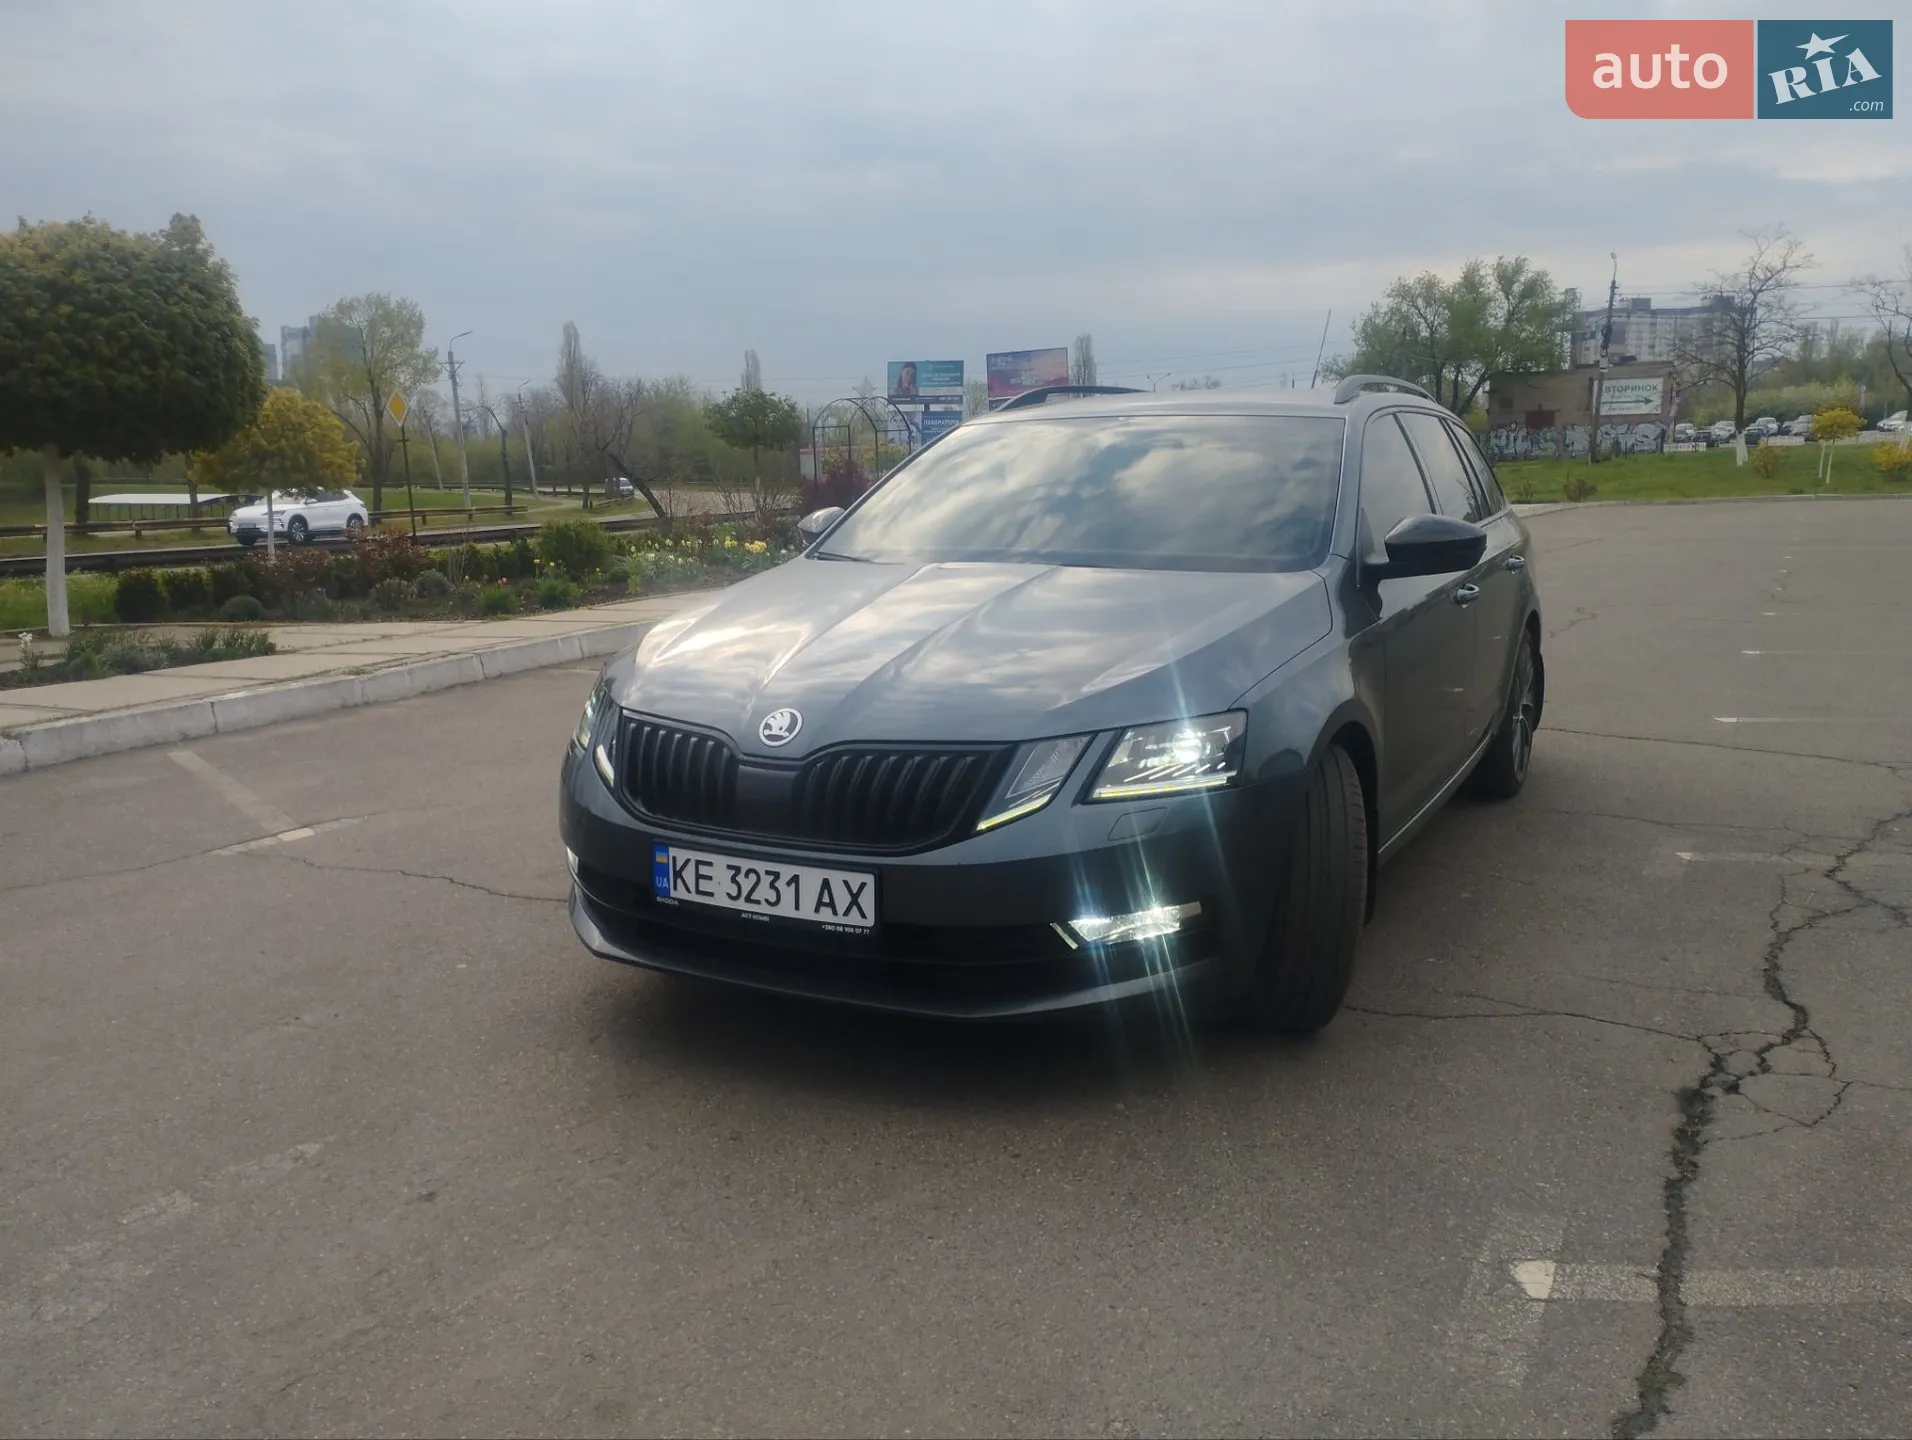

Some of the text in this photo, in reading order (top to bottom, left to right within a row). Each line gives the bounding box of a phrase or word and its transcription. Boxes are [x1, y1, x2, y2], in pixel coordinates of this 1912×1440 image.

[1604, 383, 1658, 394] ВТОРИНОК
[656, 876, 669, 889] UA
[671, 855, 868, 920] KE 3231 AX
